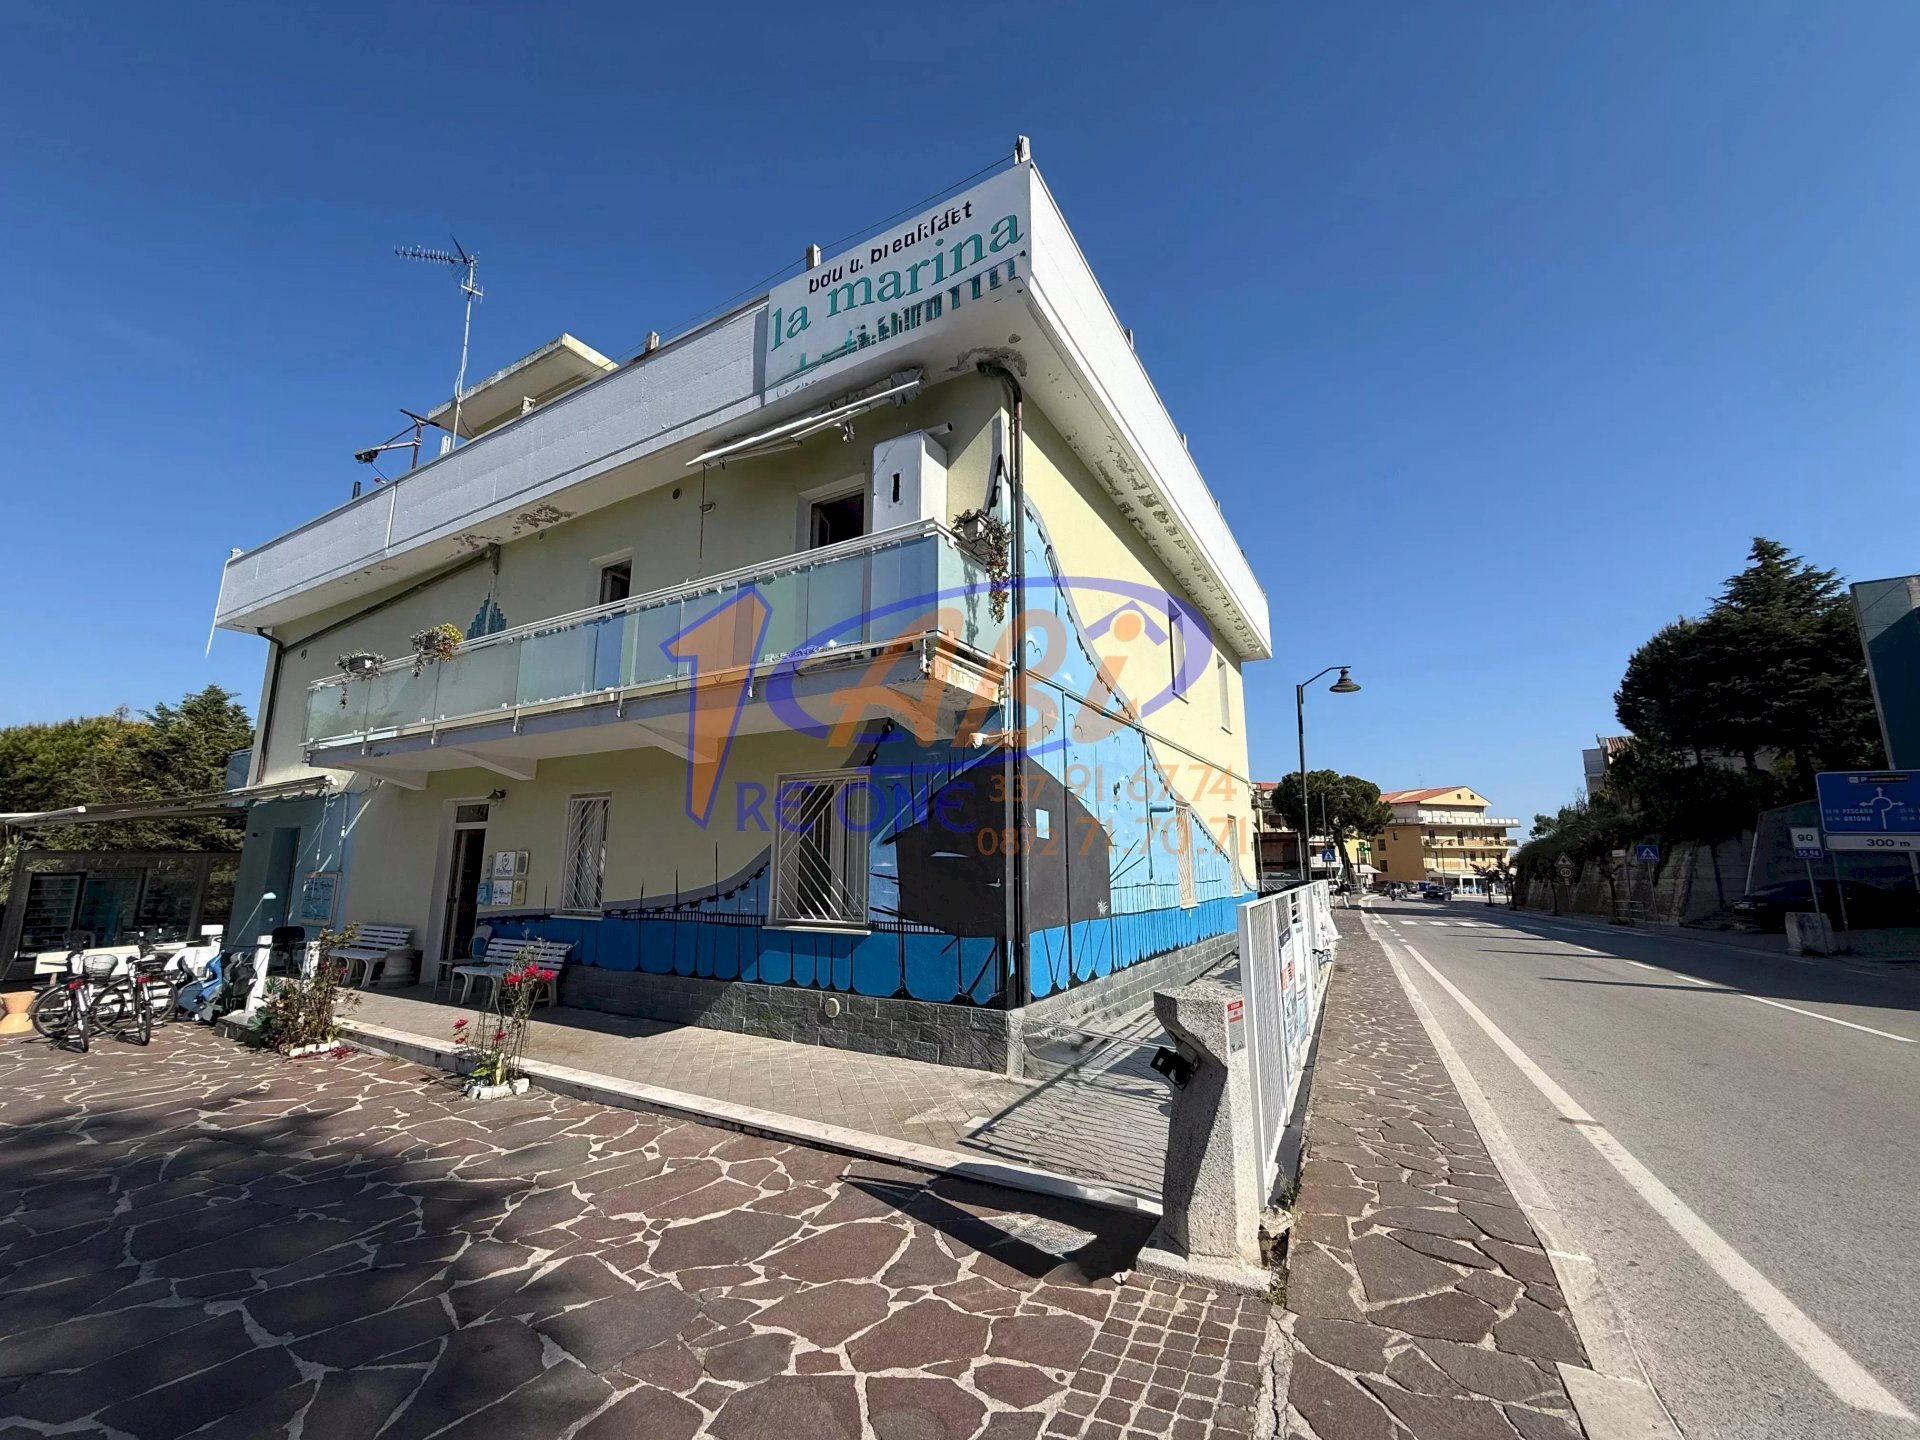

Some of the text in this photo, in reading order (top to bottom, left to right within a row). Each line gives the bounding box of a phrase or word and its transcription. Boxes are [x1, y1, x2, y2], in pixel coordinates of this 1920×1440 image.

[769, 212, 1025, 352] la marina
[1797, 834, 1814, 842] 90
[1866, 838, 1911, 848] 300 m
[1561, 868, 1572, 877] 50
